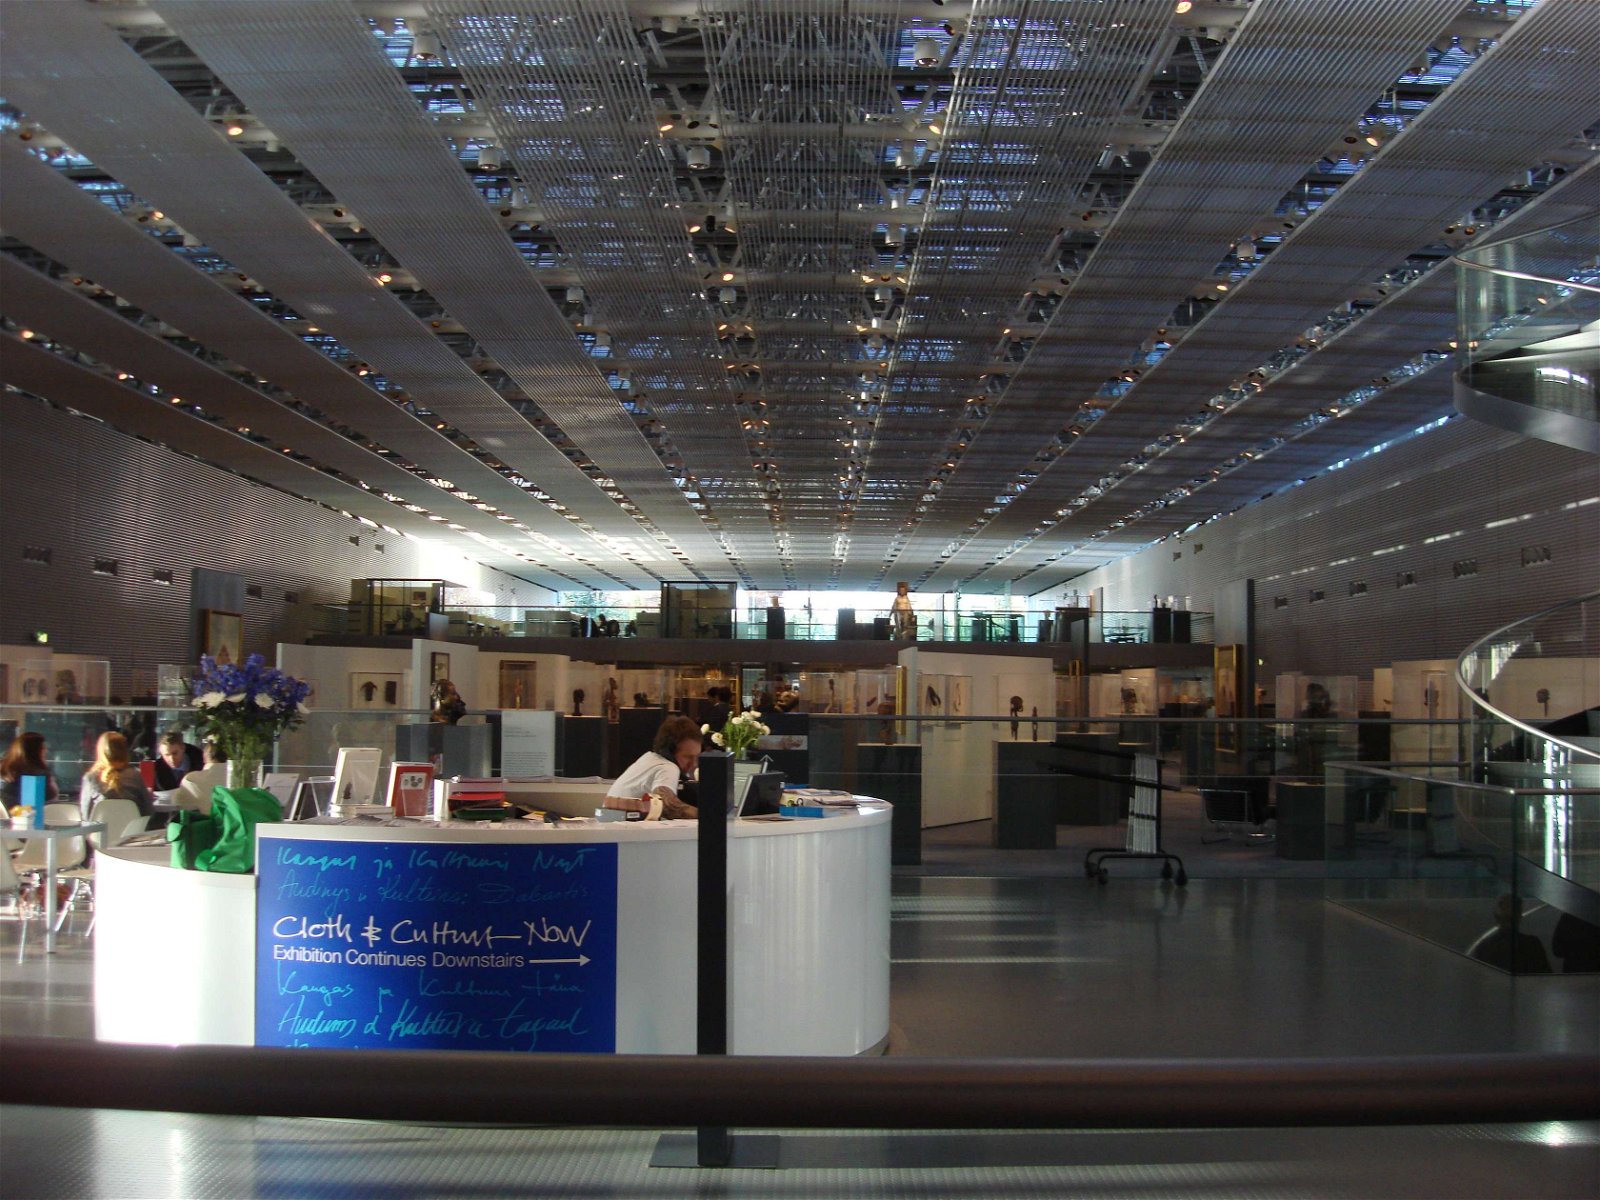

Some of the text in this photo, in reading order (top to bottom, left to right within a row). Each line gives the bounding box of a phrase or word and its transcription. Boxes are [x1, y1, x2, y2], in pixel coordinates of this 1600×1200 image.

[272, 914, 353, 943] Cloth
[360, 915, 383, 948] &
[273, 944, 525, 968] Exhibition Continues Downstairs
